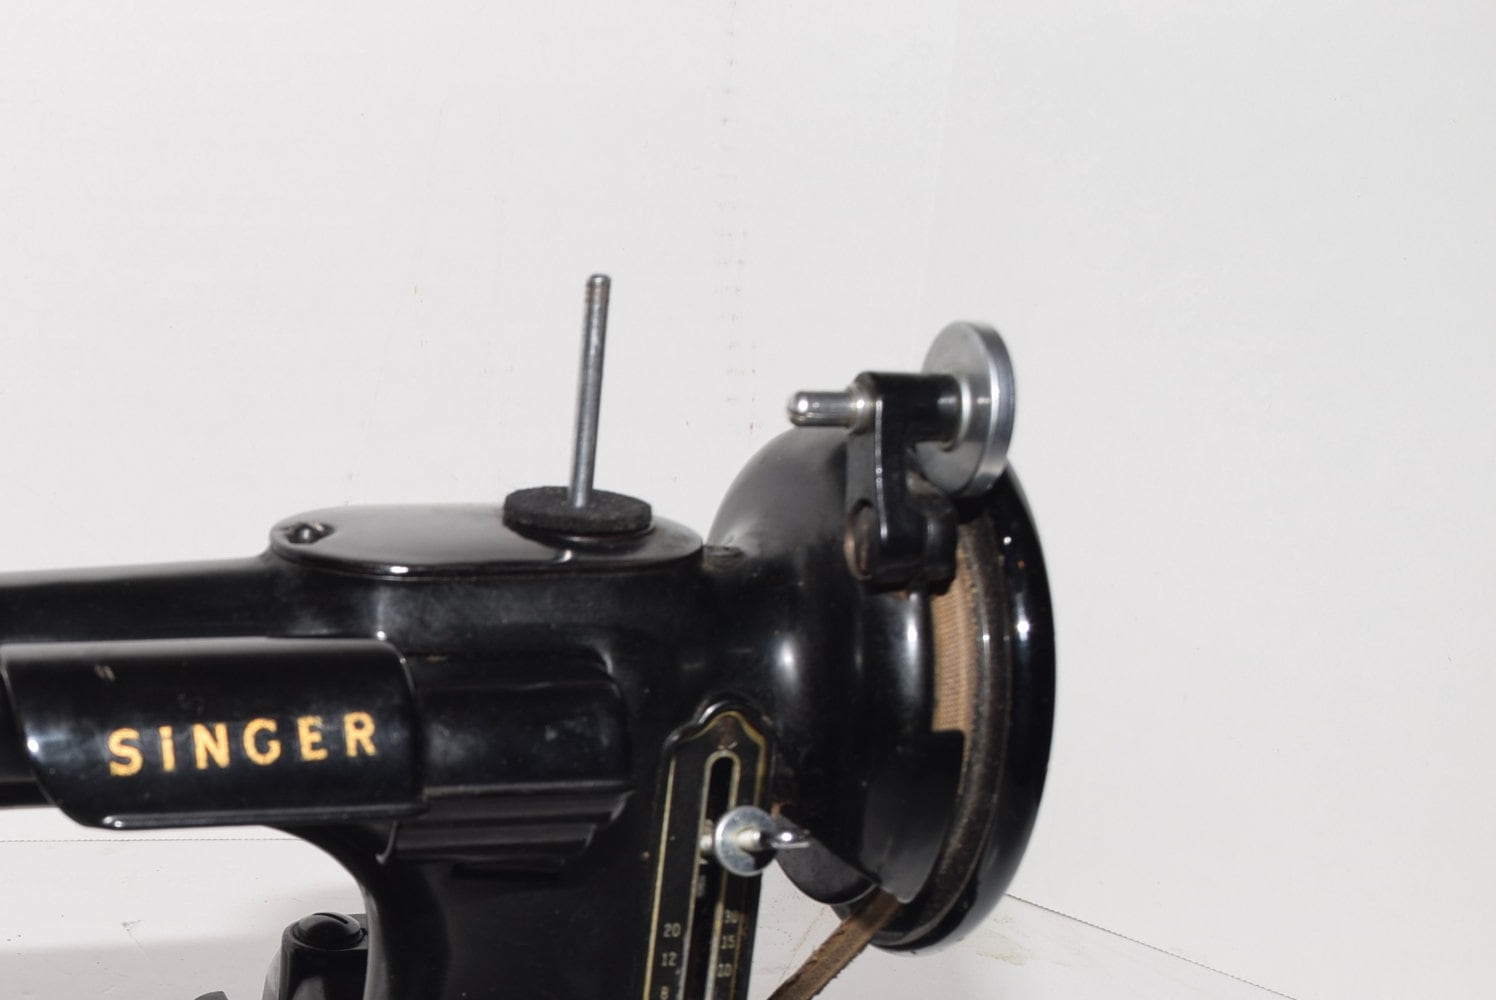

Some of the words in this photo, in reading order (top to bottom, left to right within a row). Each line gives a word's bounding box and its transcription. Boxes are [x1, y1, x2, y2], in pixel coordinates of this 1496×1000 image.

[108, 711, 377, 777] SINGER
[663, 923, 682, 939] 20
[661, 951, 678, 967] 12
